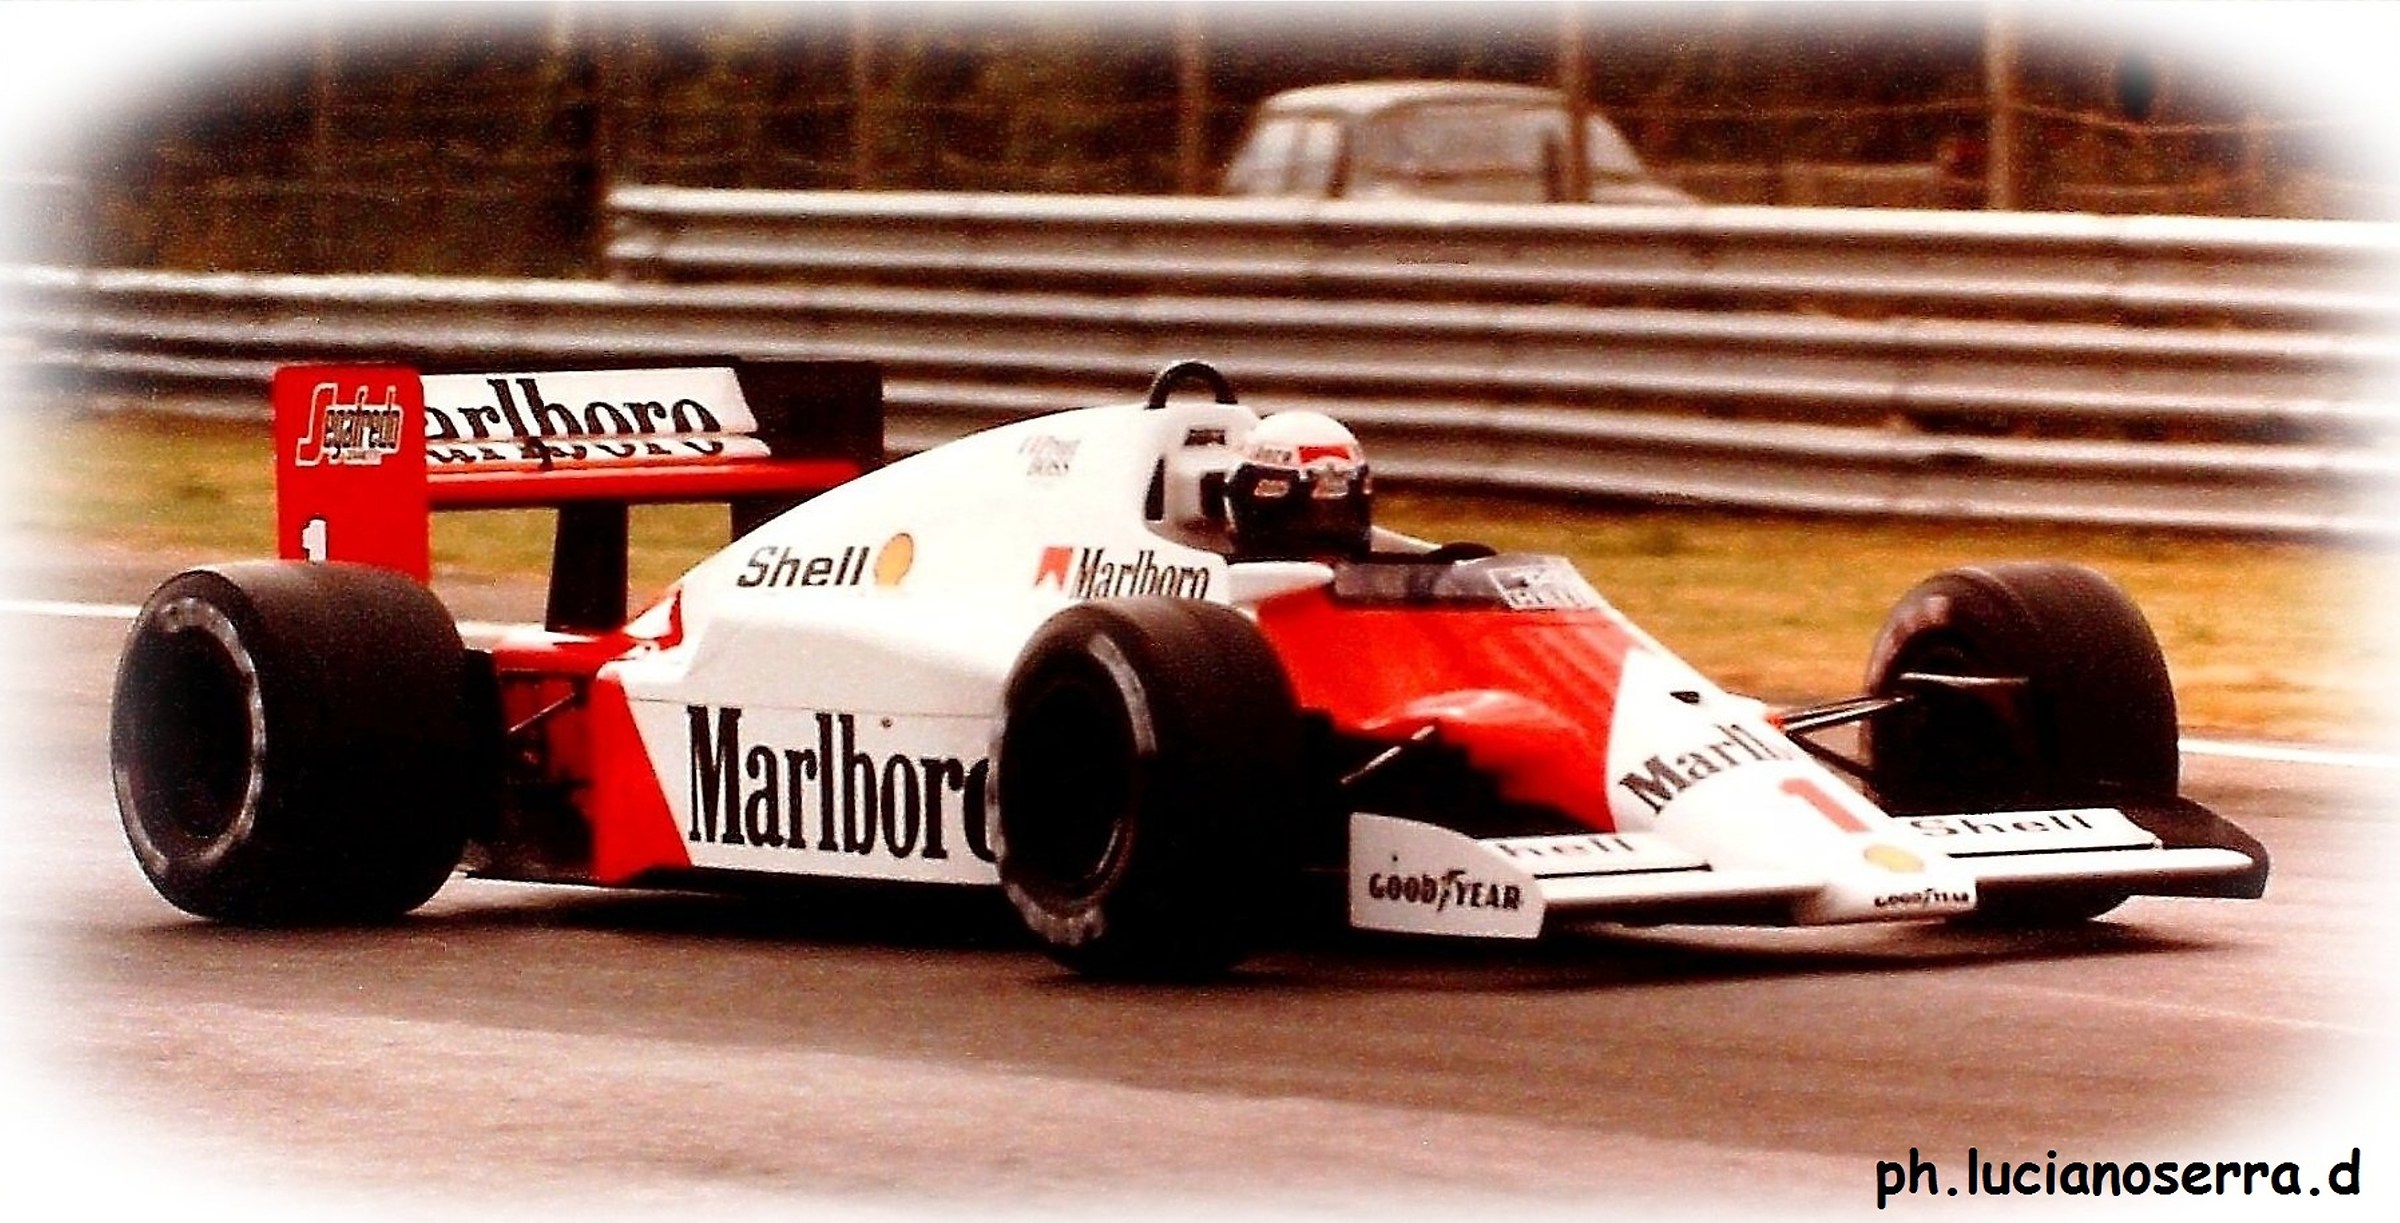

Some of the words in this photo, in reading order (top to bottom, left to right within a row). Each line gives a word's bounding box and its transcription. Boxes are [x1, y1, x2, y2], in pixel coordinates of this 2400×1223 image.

[423, 378, 724, 460] arlboro
[302, 518, 327, 561] 1
[736, 546, 870, 588] Shell
[1072, 548, 1209, 599] Marlboro
[1779, 778, 1872, 833] 1
[1910, 813, 2093, 837] Shell
[1497, 838, 1635, 857] hell
